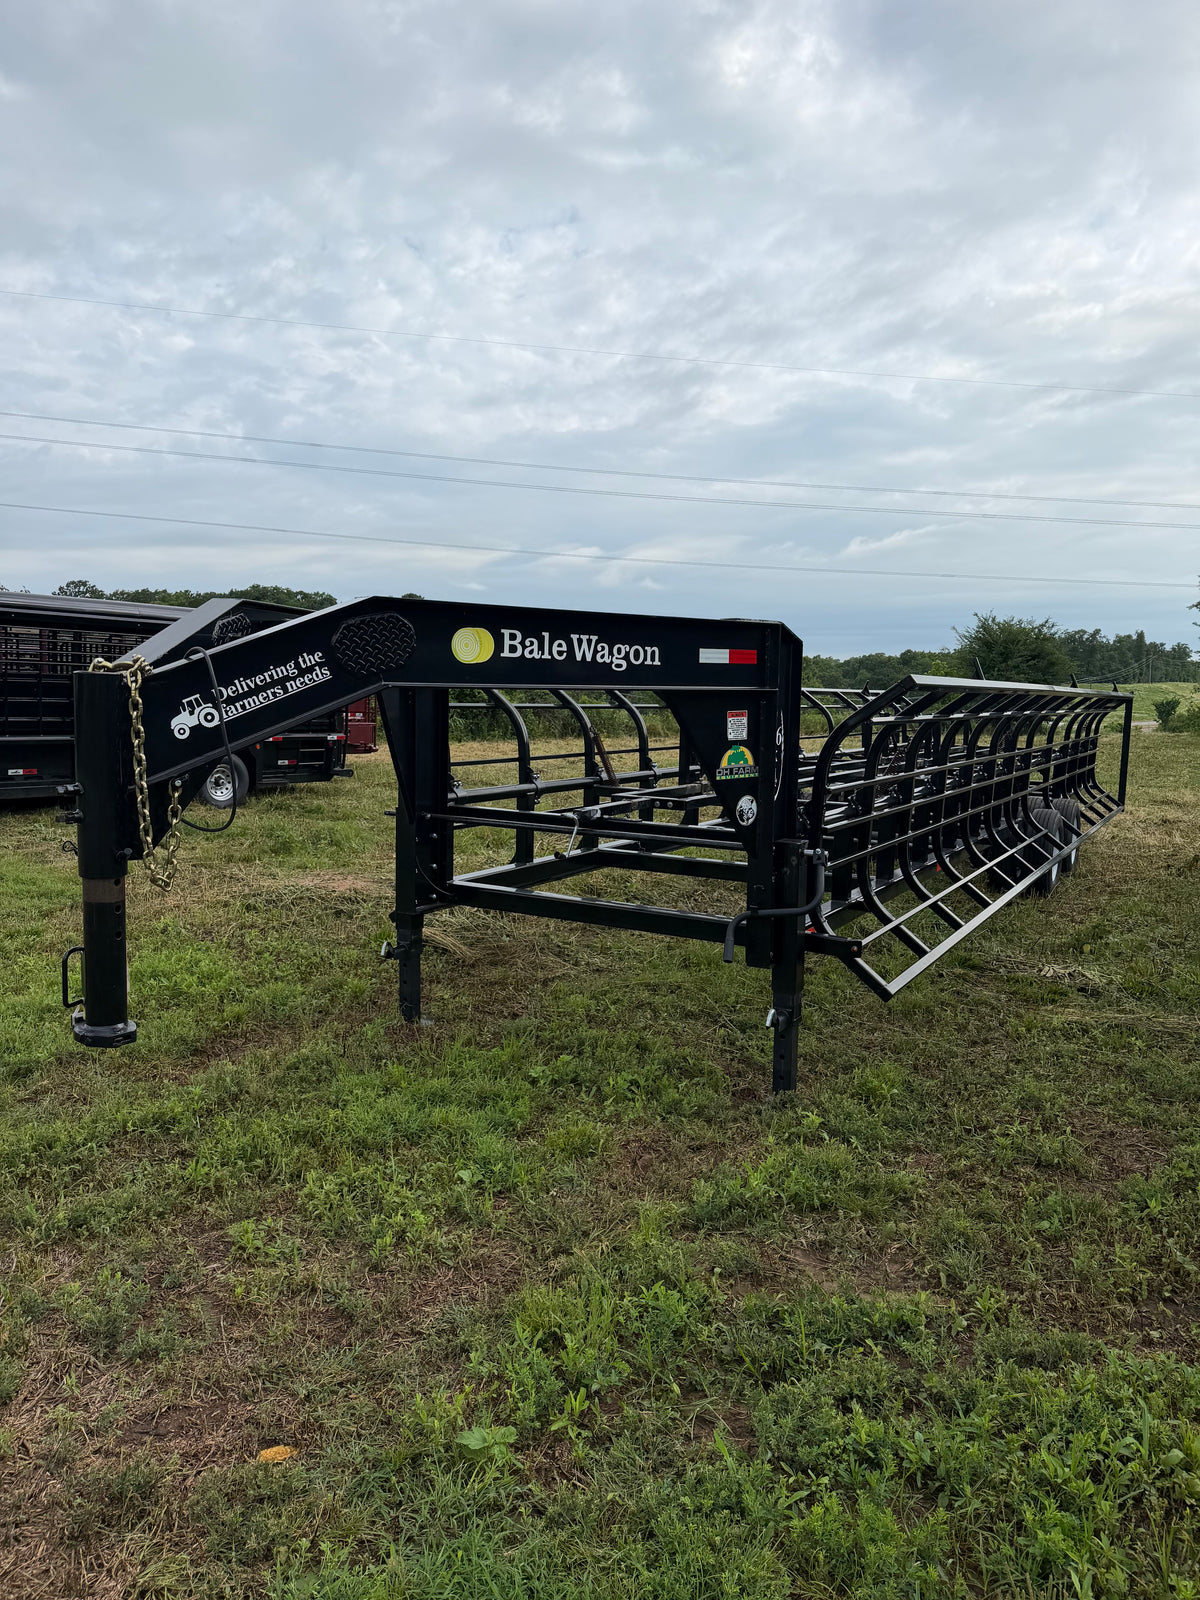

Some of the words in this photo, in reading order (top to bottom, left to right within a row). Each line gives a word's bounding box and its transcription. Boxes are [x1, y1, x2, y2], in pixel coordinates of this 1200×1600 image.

[500, 628, 568, 661] Bale
[570, 634, 661, 672] Wagon
[211, 661, 298, 703] Delivering
[298, 651, 325, 669] the
[221, 685, 284, 719] farmers
[285, 666, 331, 693] needs
[733, 766, 759, 775] FARM
